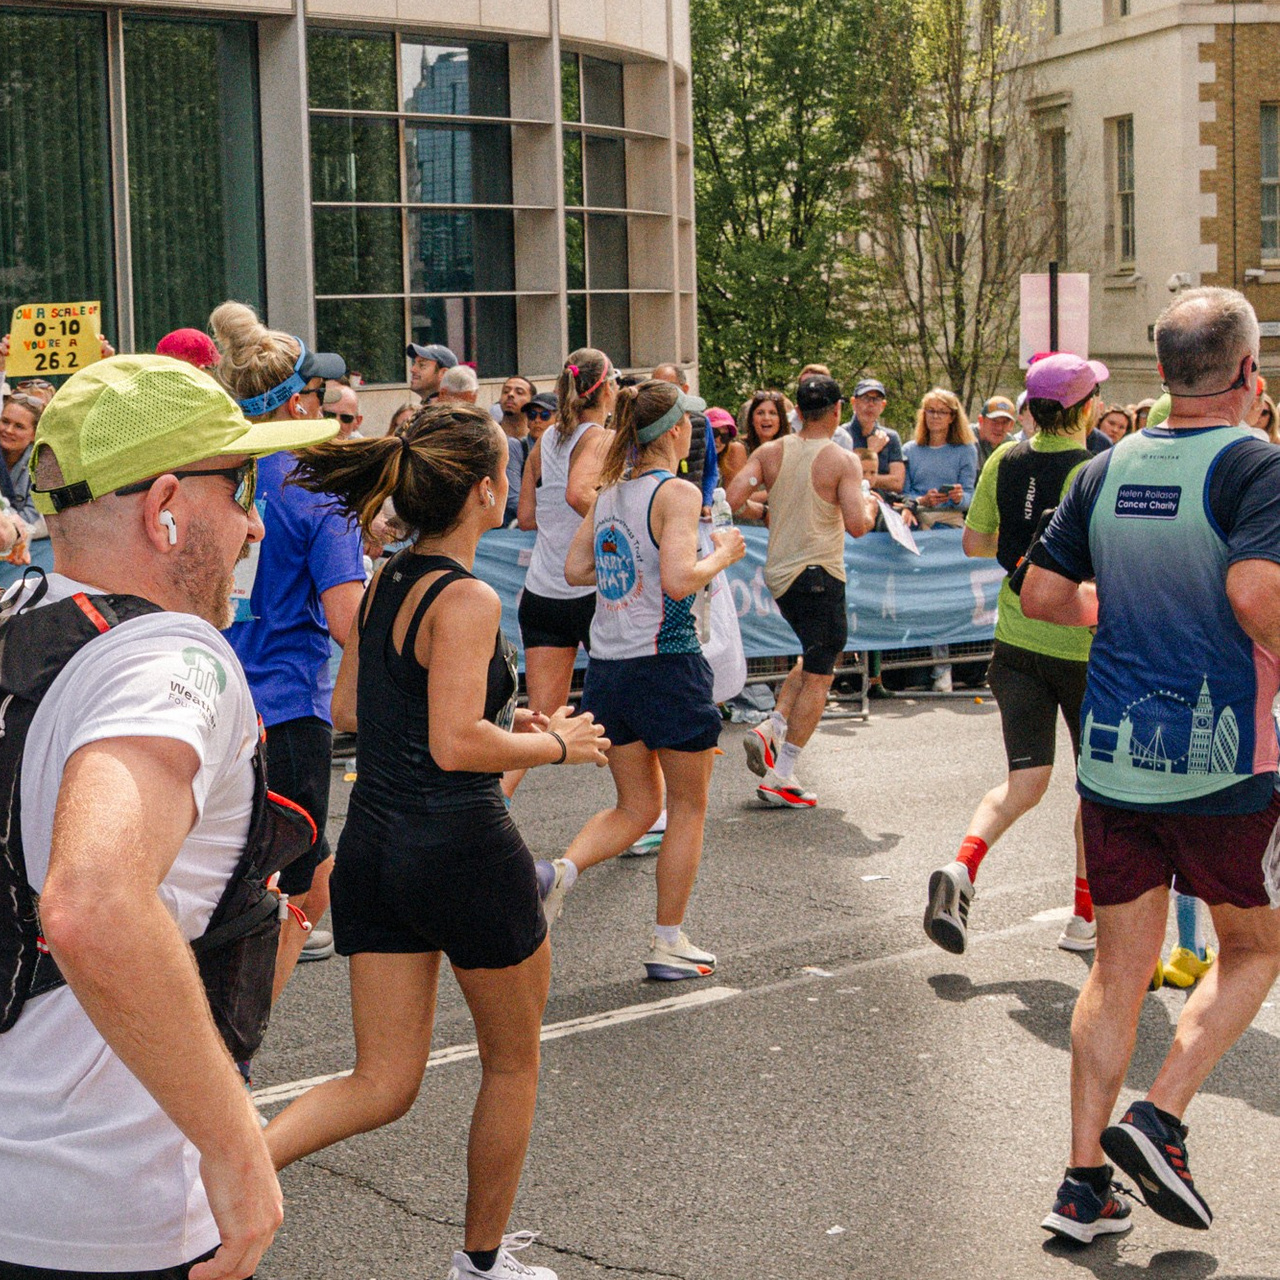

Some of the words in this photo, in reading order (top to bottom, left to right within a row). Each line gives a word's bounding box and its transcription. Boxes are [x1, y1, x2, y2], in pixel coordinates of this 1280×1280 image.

[16, 308, 31, 319] ON
[36, 307, 45, 318] A
[51, 306, 86, 318] SCALE
[88, 306, 98, 315] OF
[34, 319, 80, 337] 0-10
[69, 339, 77, 347] A
[34, 351, 78, 371] 26.2
[1024, 477, 1036, 519] KIPRUN
[1119, 489, 1143, 498] Helen
[1118, 499, 1147, 509] Cancer
[1149, 500, 1177, 511] Charity
